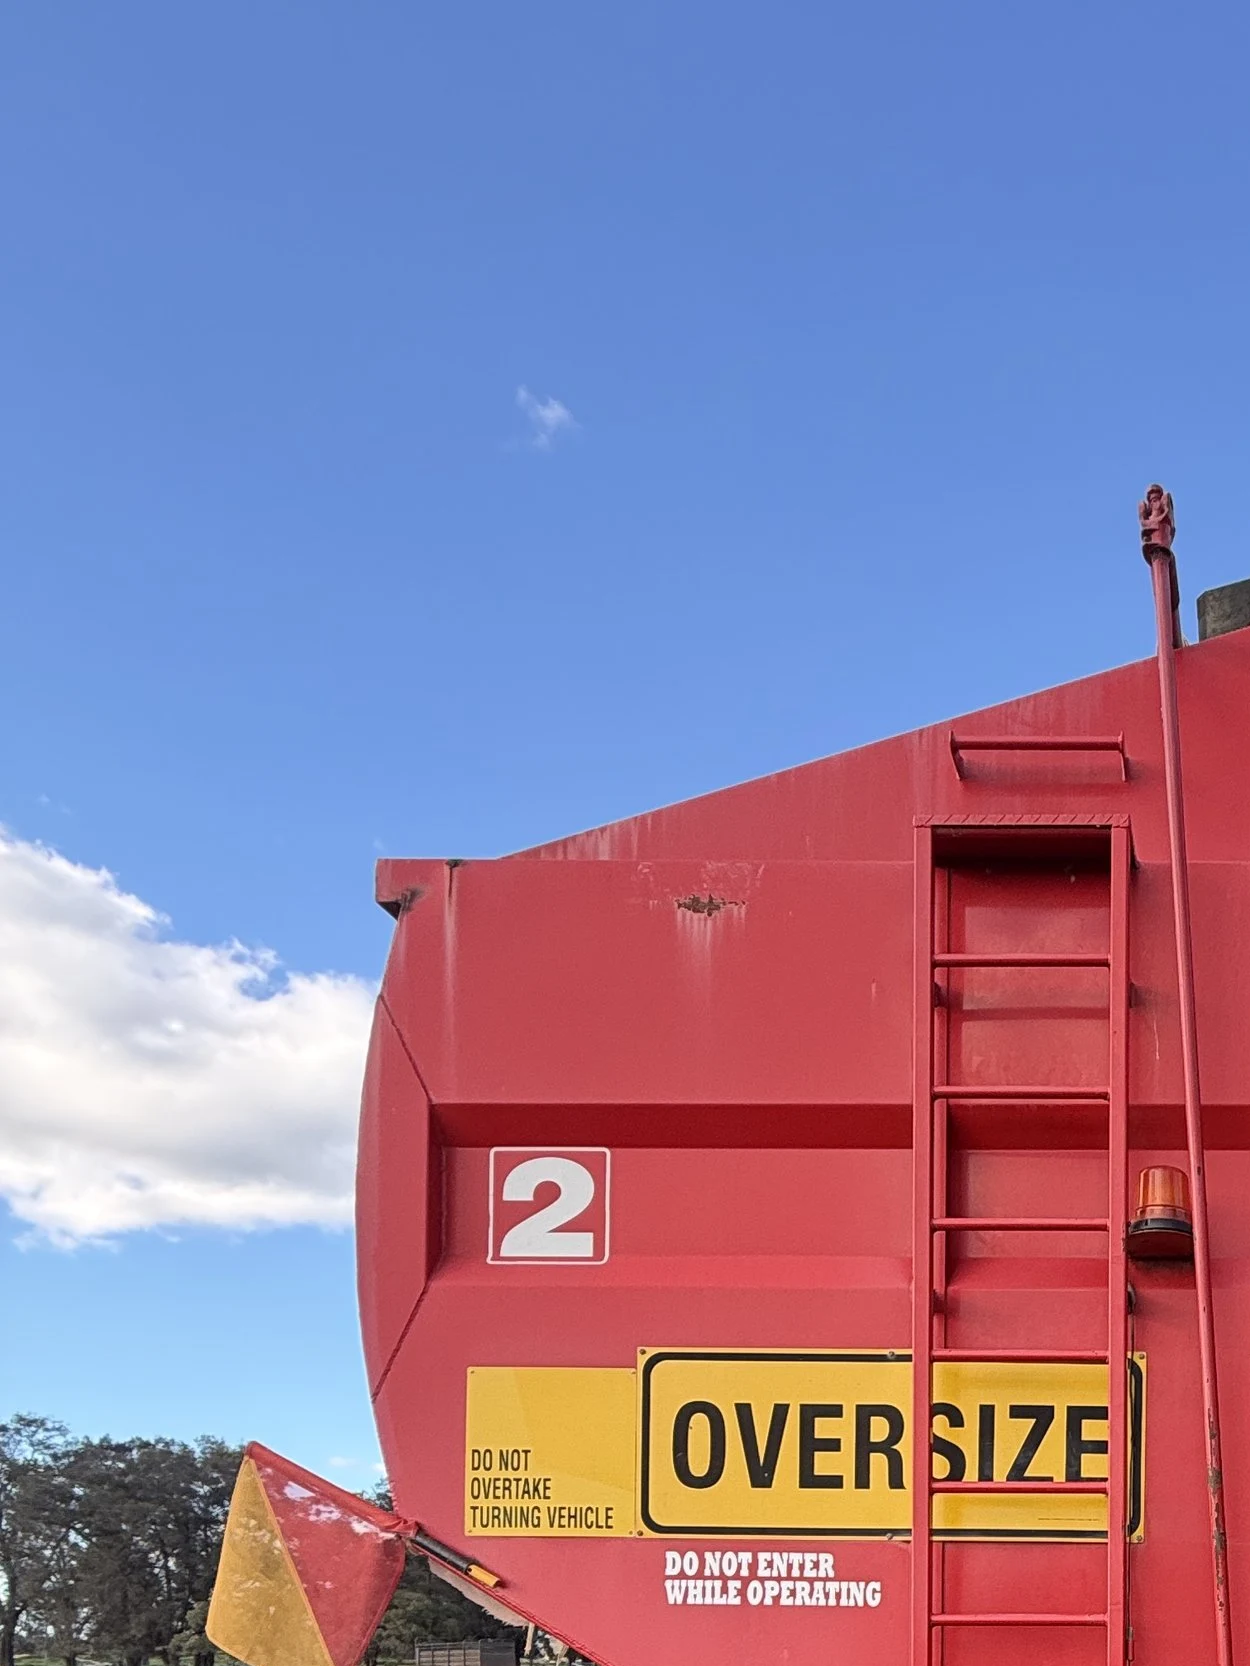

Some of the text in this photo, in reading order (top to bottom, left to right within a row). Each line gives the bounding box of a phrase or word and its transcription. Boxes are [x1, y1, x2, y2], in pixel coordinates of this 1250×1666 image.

[500, 1157, 595, 1257] 2
[672, 1401, 1109, 1490] OVERSIZE
[471, 1449, 531, 1472] DO NOT
[471, 1477, 552, 1500] OVERTAKE
[470, 1505, 614, 1529] TURNING VEHICLE
[665, 1551, 835, 1578] DO NOT ENTER
[664, 1579, 881, 1607] WHILE OPERATING
